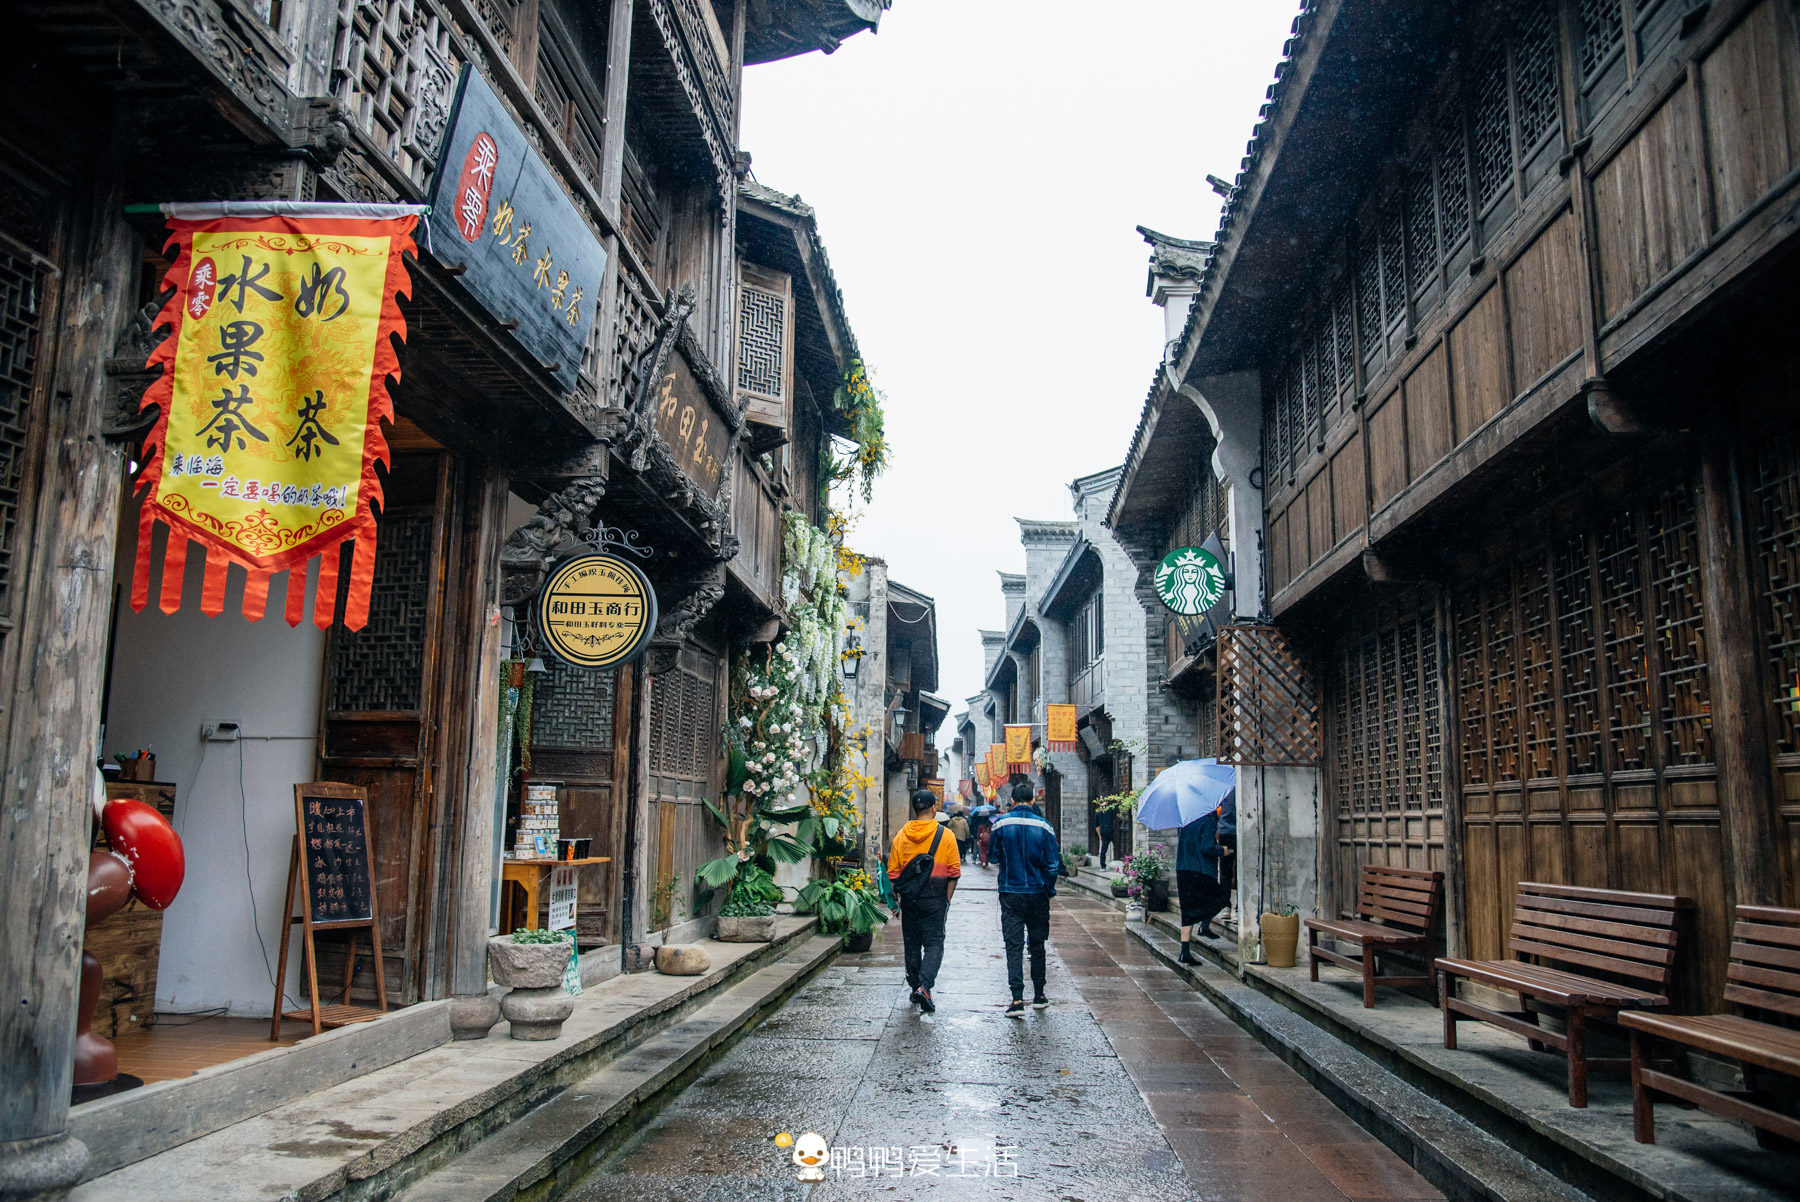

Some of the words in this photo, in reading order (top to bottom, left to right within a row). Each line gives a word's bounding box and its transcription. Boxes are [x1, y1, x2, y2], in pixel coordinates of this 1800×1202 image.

[190, 262, 215, 317] 乘零
[493, 199, 530, 266] 奶茶
[533, 246, 583, 326] 水果茶
[195, 254, 284, 453] 水果茶
[286, 262, 350, 462] 奶茶
[171, 453, 224, 475] 来临海
[551, 601, 640, 616] 和田玉商行
